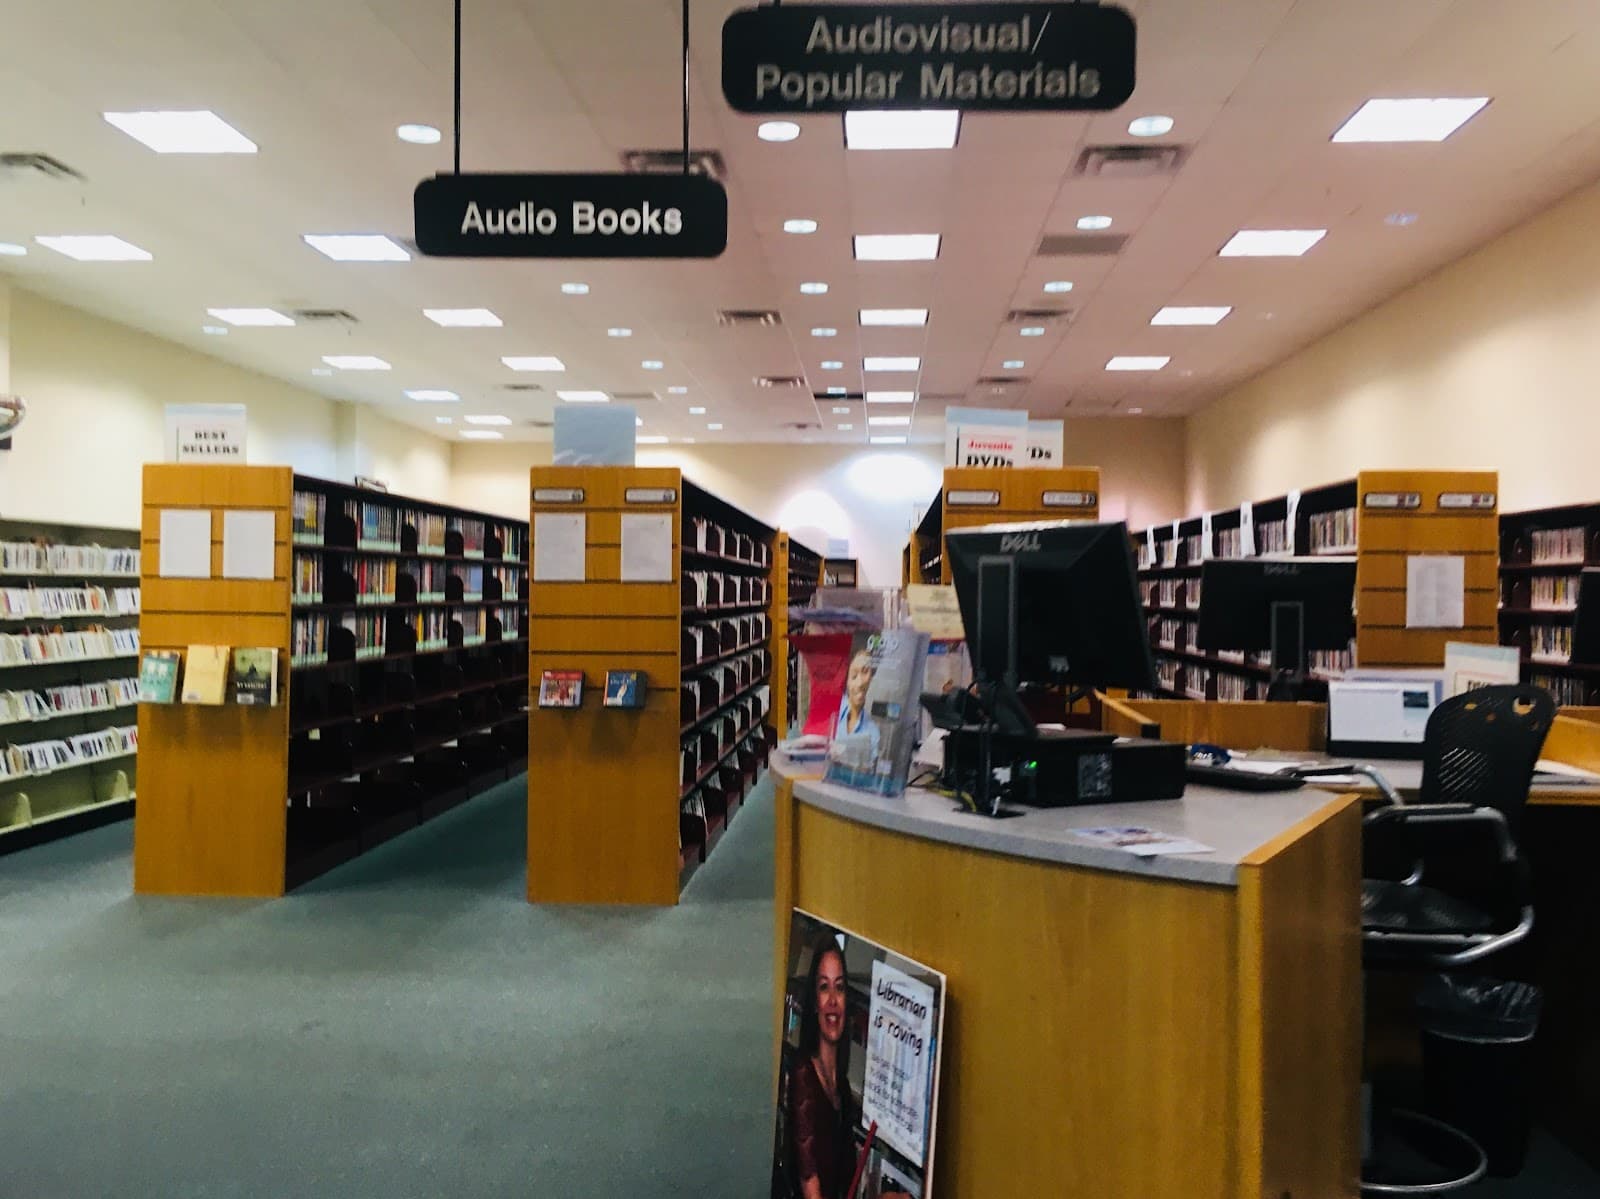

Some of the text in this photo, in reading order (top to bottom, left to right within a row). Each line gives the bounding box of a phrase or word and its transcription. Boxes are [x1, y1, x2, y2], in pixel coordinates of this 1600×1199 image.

[805, 11, 1051, 55] Audiovisual/
[756, 61, 1101, 107] Popular Materials
[460, 201, 682, 235] Audio Books
[194, 431, 227, 440] BEST
[968, 440, 1013, 451] Juvenile
[182, 445, 239, 454] SELLERS
[966, 455, 1013, 467] DVDs
[1000, 533, 1041, 552] DELL
[877, 977, 927, 1020] Librarian
[873, 1009, 923, 1056] is roving
